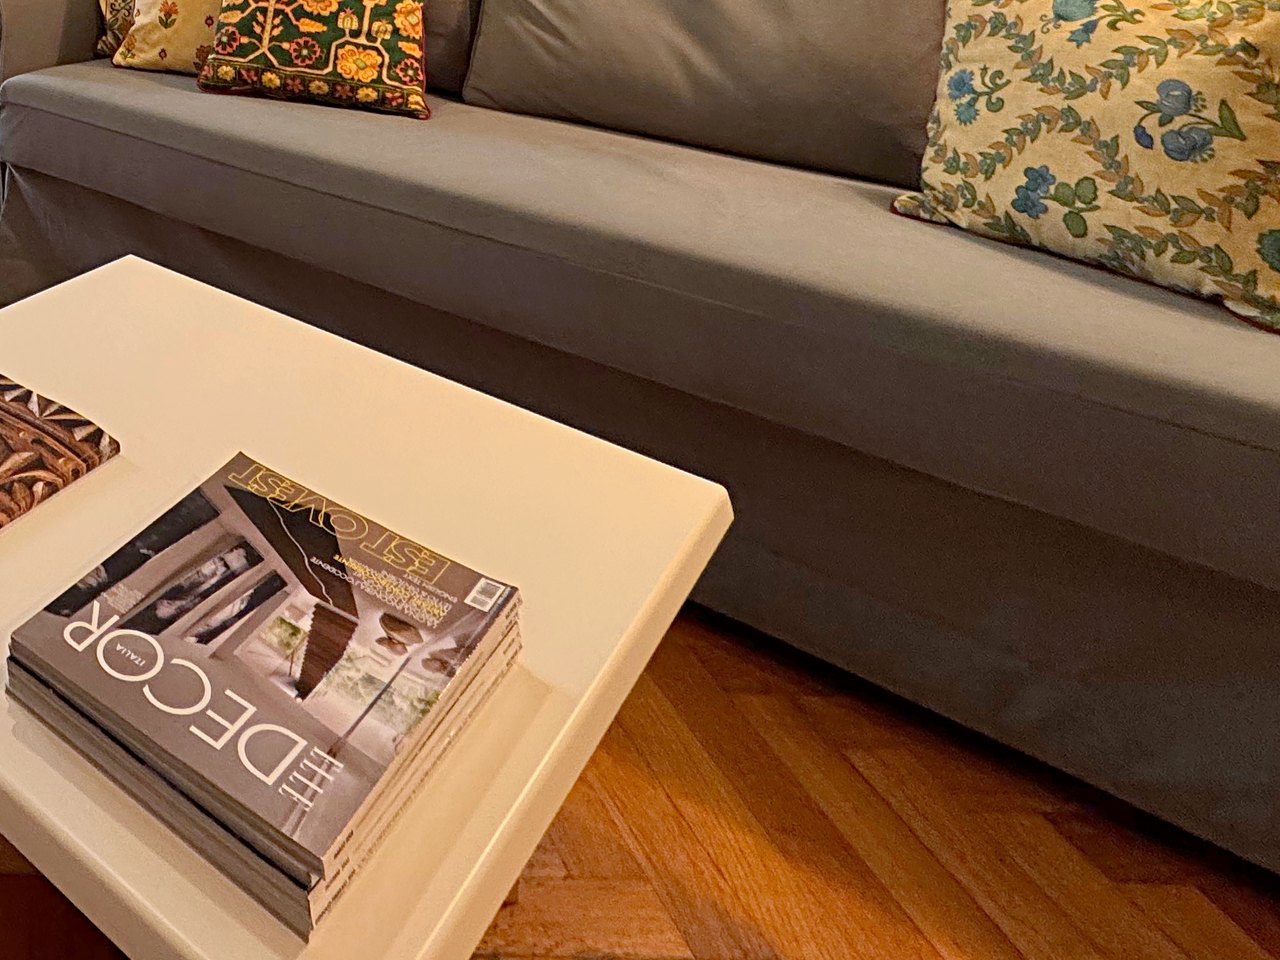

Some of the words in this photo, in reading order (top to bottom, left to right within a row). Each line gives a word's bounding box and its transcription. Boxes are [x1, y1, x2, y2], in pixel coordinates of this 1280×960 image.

[227, 463, 370, 541] OVEST
[360, 531, 451, 585] EST
[115, 642, 146, 667] ITALIA
[62, 599, 308, 786] DECOR
[277, 746, 345, 812] ELLE
